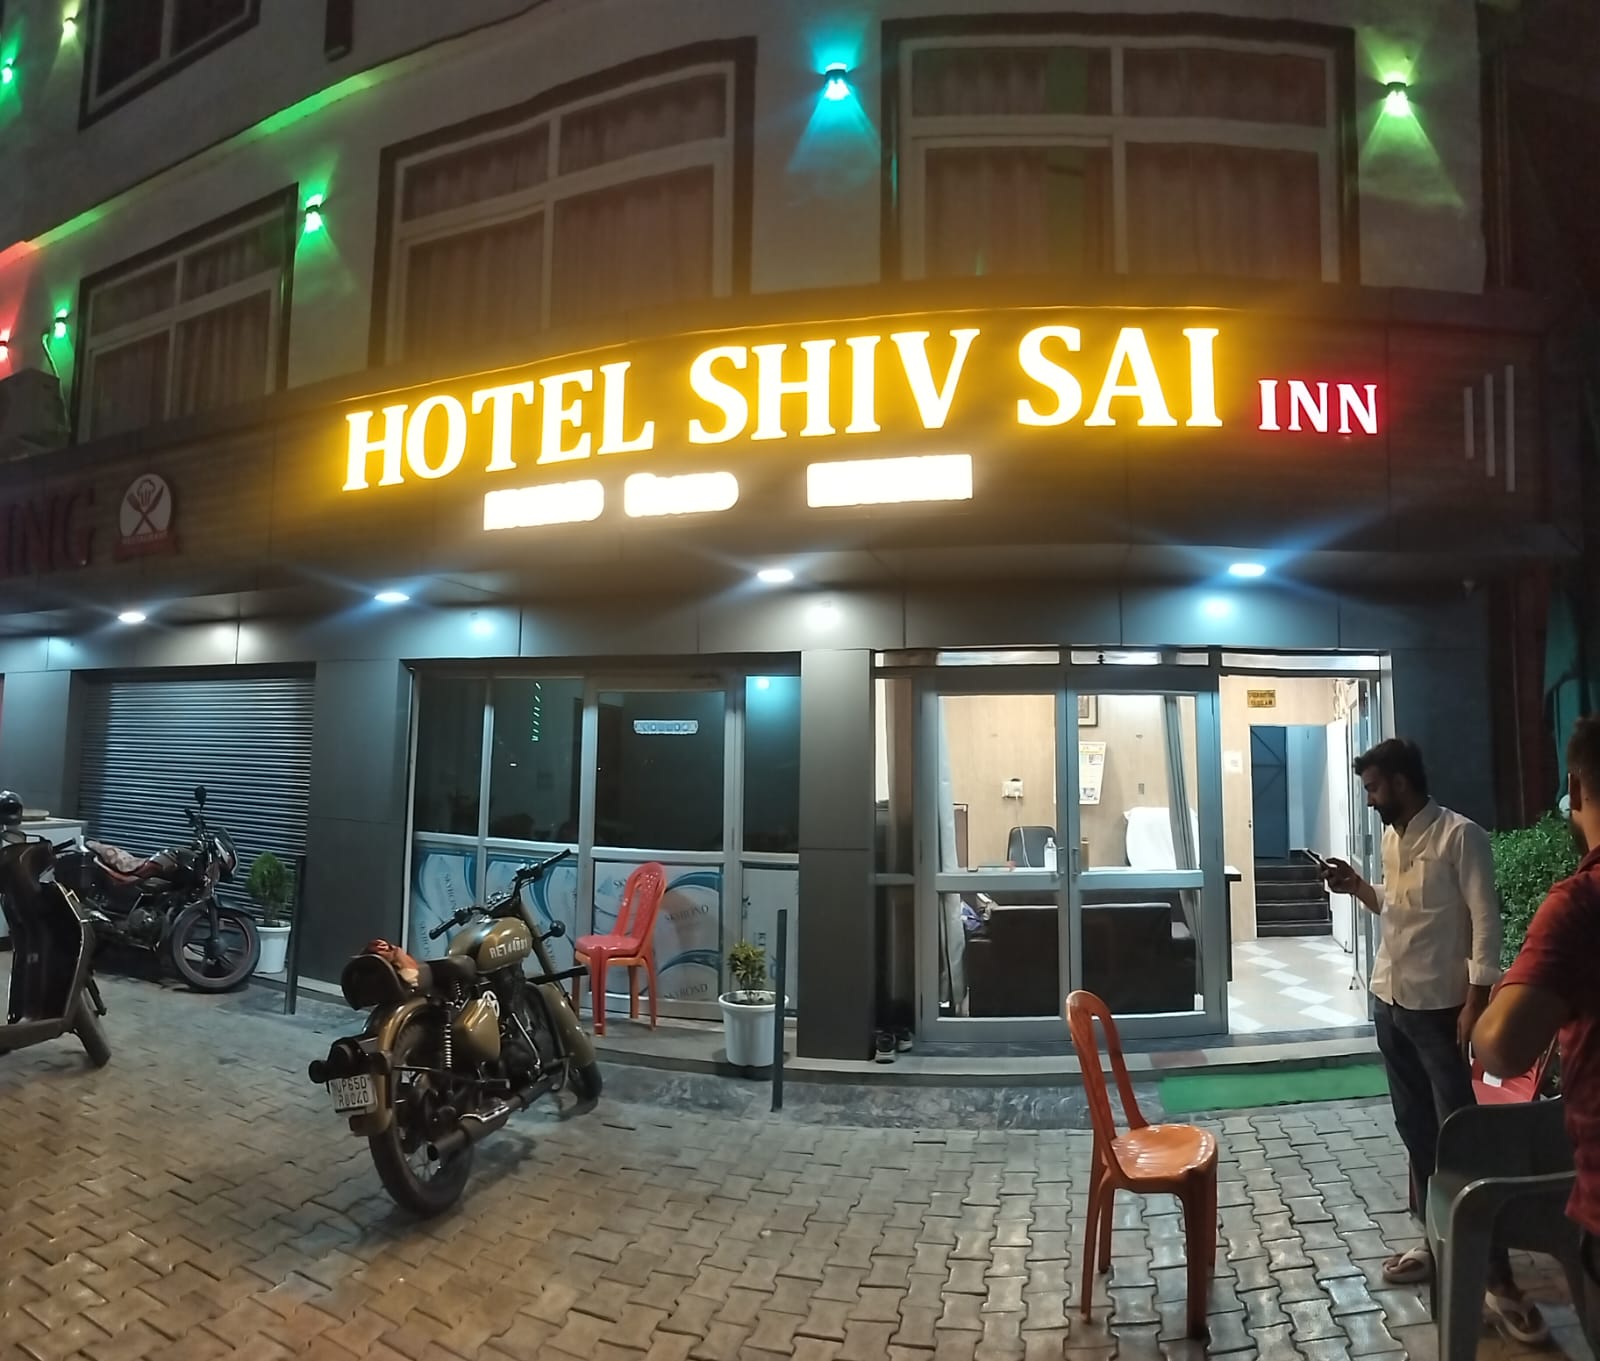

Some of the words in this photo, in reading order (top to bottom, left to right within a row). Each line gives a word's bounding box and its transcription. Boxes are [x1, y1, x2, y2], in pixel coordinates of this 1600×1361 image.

[343, 361, 655, 491] HOTEL
[688, 328, 980, 444] SHIV
[1017, 325, 1223, 427] SAI
[1259, 379, 1377, 434] INN
